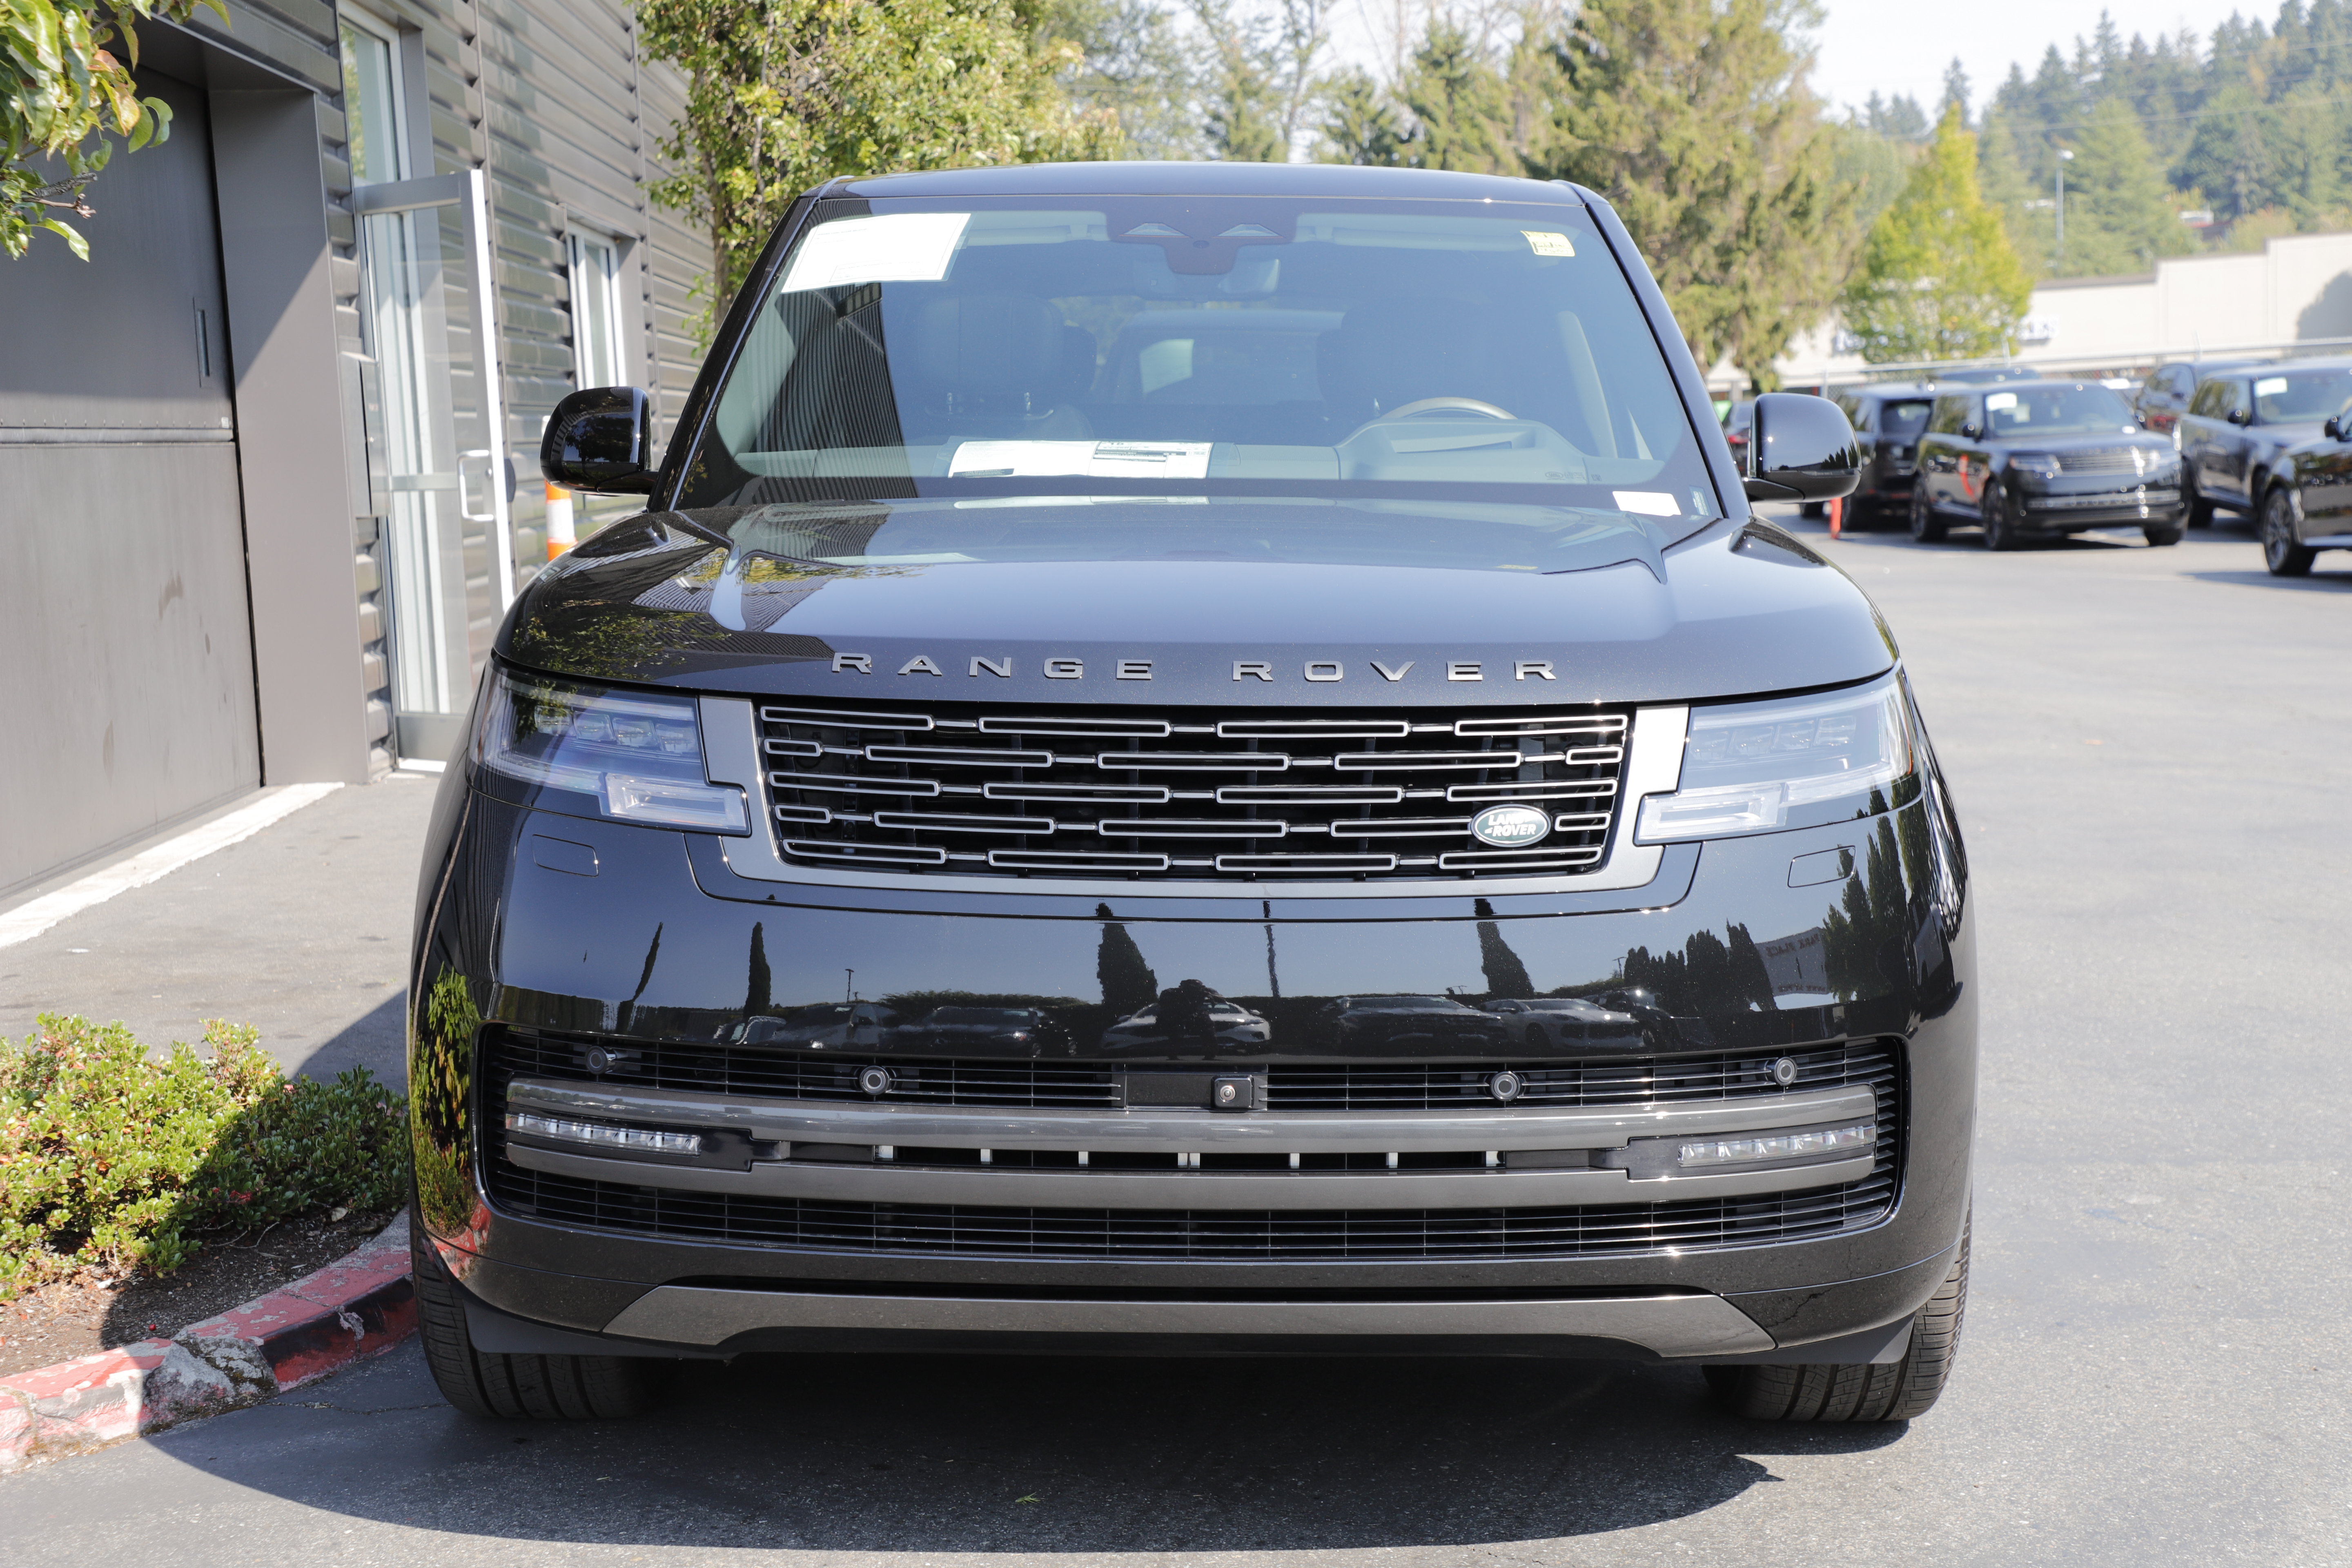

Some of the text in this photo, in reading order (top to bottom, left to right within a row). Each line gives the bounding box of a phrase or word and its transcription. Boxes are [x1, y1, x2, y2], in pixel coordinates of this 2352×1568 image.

[831, 652, 1557, 682] RANGE ROVER
[1489, 814, 1524, 825] LAND
[1492, 824, 1536, 836] ROVER
